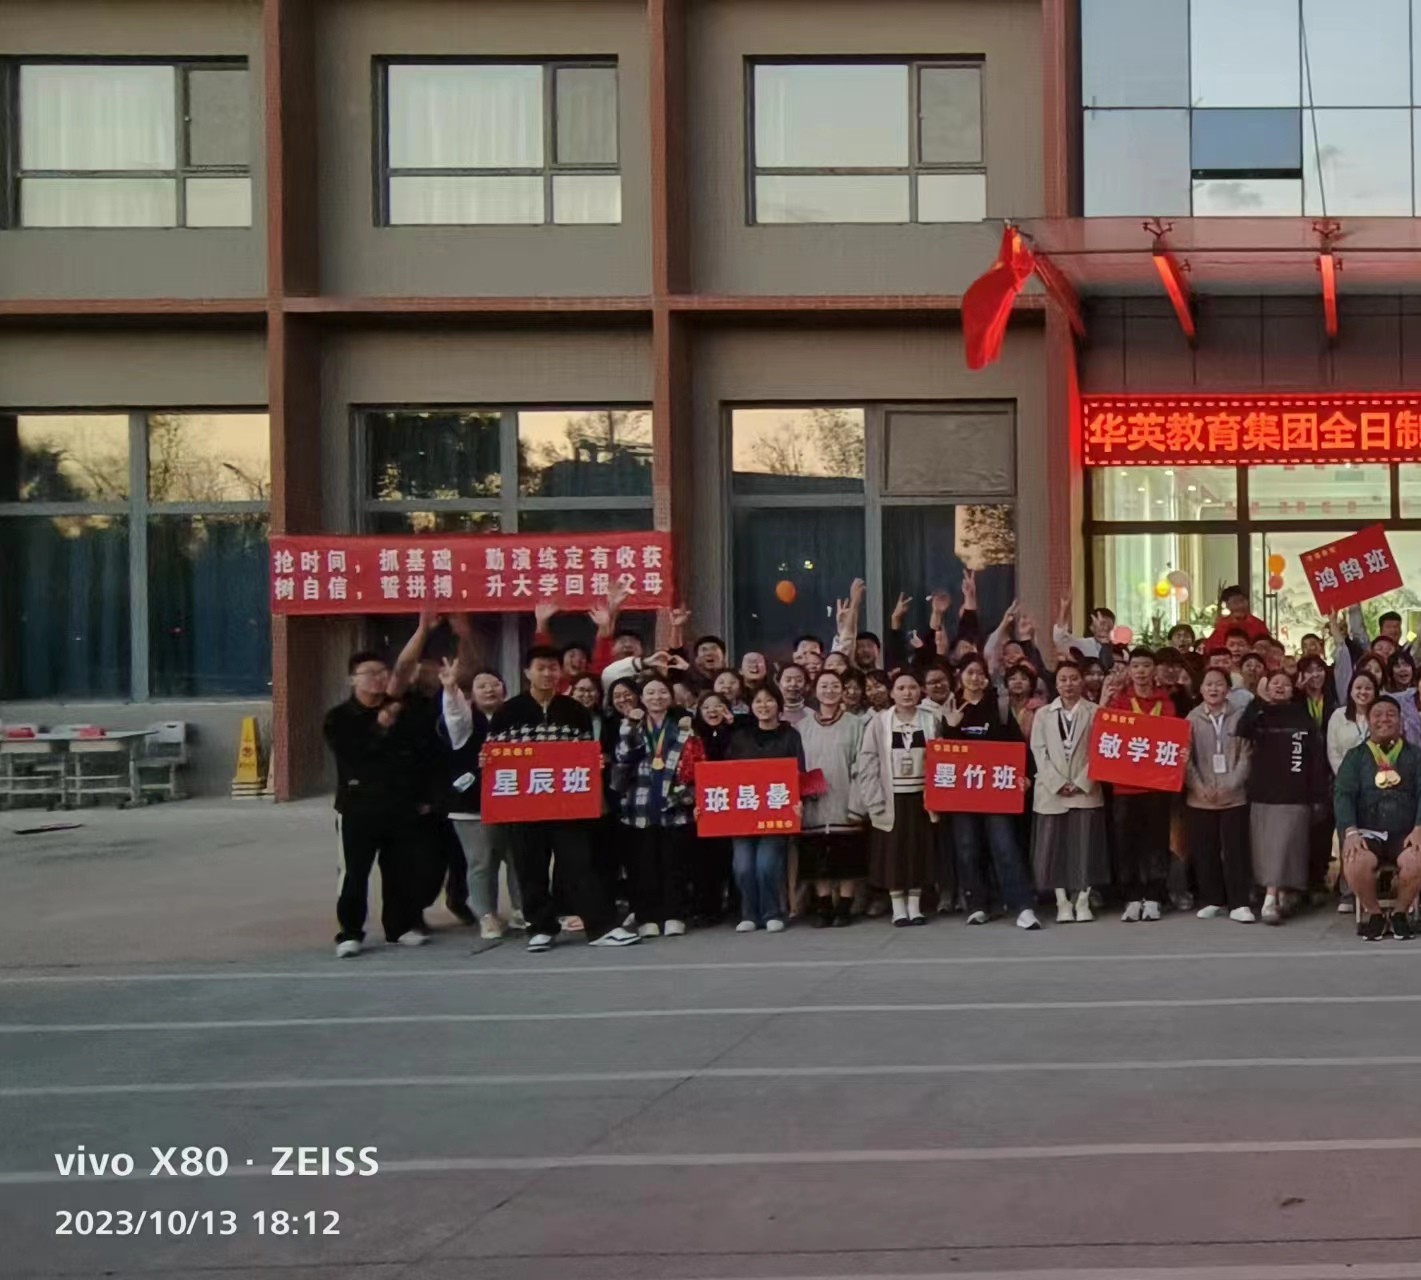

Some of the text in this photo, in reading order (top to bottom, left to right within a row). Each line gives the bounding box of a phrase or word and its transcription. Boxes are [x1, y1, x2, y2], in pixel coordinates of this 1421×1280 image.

[1314, 549, 1389, 592] 鸿鹄班
[1098, 732, 1180, 767] 敏学班
[491, 766, 591, 797] 星辰班
[934, 763, 1016, 790] 墨竹班
[704, 783, 791, 812] 睿智班
